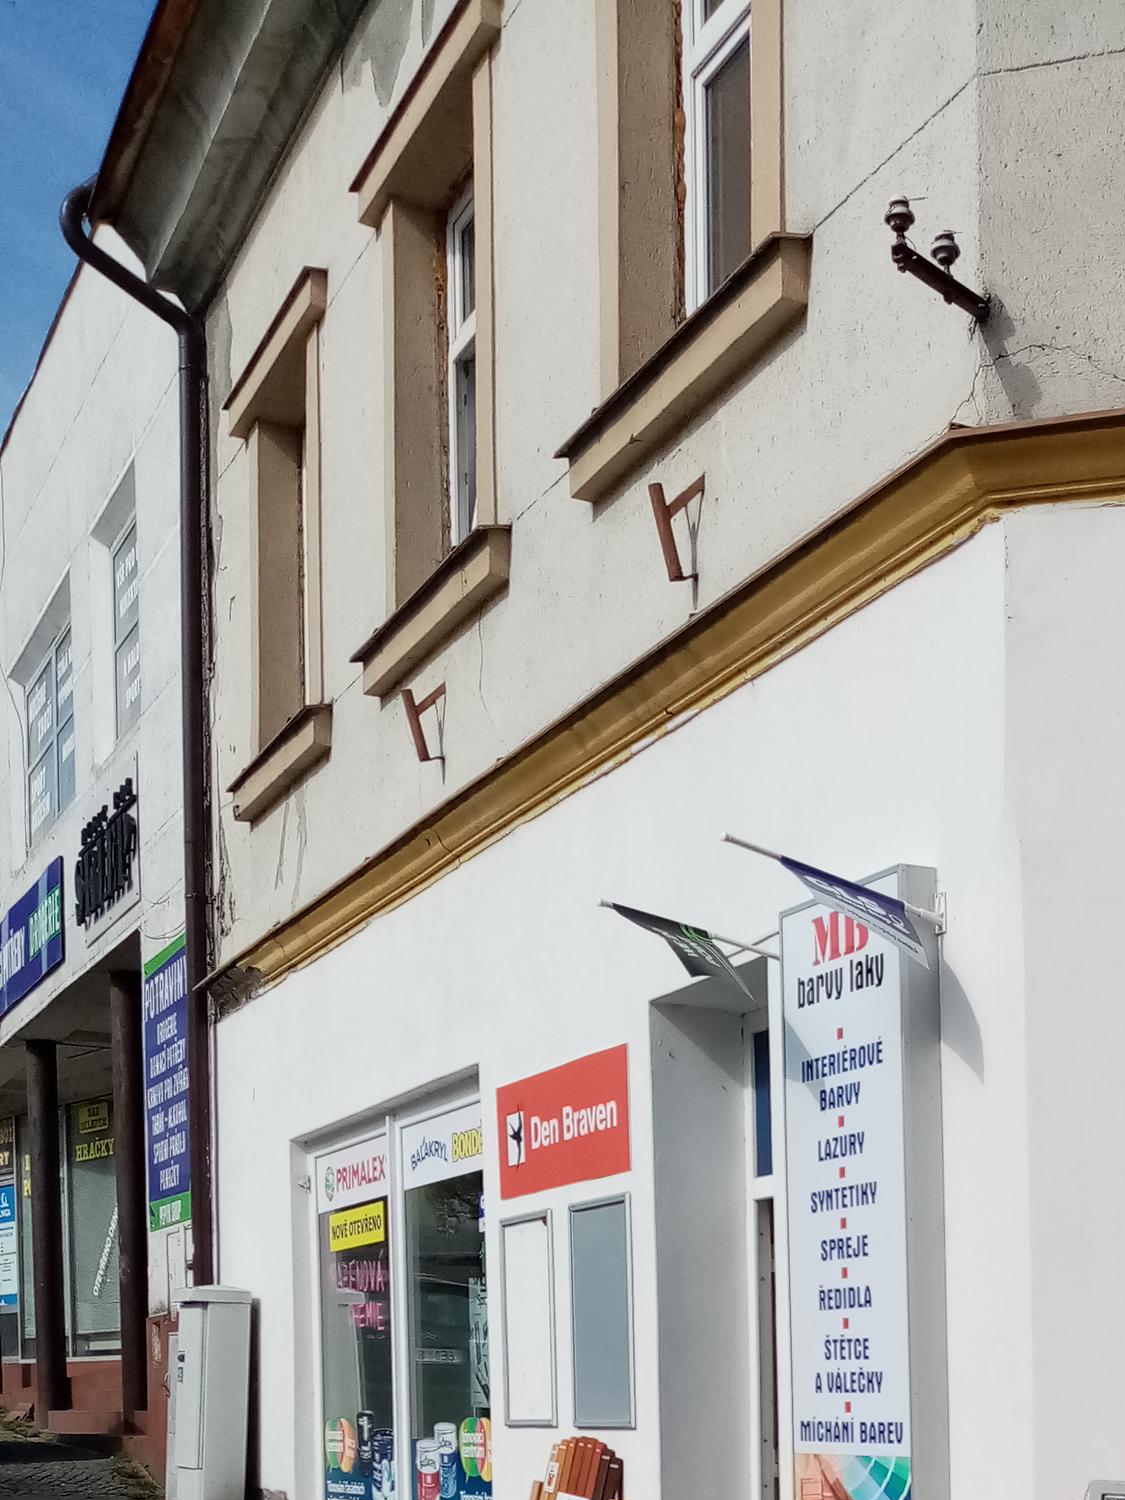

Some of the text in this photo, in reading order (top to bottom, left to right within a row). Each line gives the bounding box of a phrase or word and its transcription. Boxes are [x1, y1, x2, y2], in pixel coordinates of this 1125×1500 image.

[797, 953, 884, 1010] barvy laky
[801, 1036, 884, 1083] INTERIÉROVÉ
[819, 1081, 861, 1112] BARVY
[530, 1100, 618, 1150] Den Braven
[817, 1131, 865, 1162] LAZURY
[336, 1154, 386, 1193] PRIMALEX
[811, 1181, 877, 1214] SYNTETIKY
[349, 1213, 382, 1237] OTEVŘENO
[820, 1234, 869, 1262] SPREJE
[818, 1284, 872, 1312] ŘEDIDLA
[824, 1334, 870, 1361] ŠTĚTCE
[815, 1366, 883, 1394] A VÁLEČKY
[800, 1416, 904, 1445] MÍCHÁNÍ BAREV
